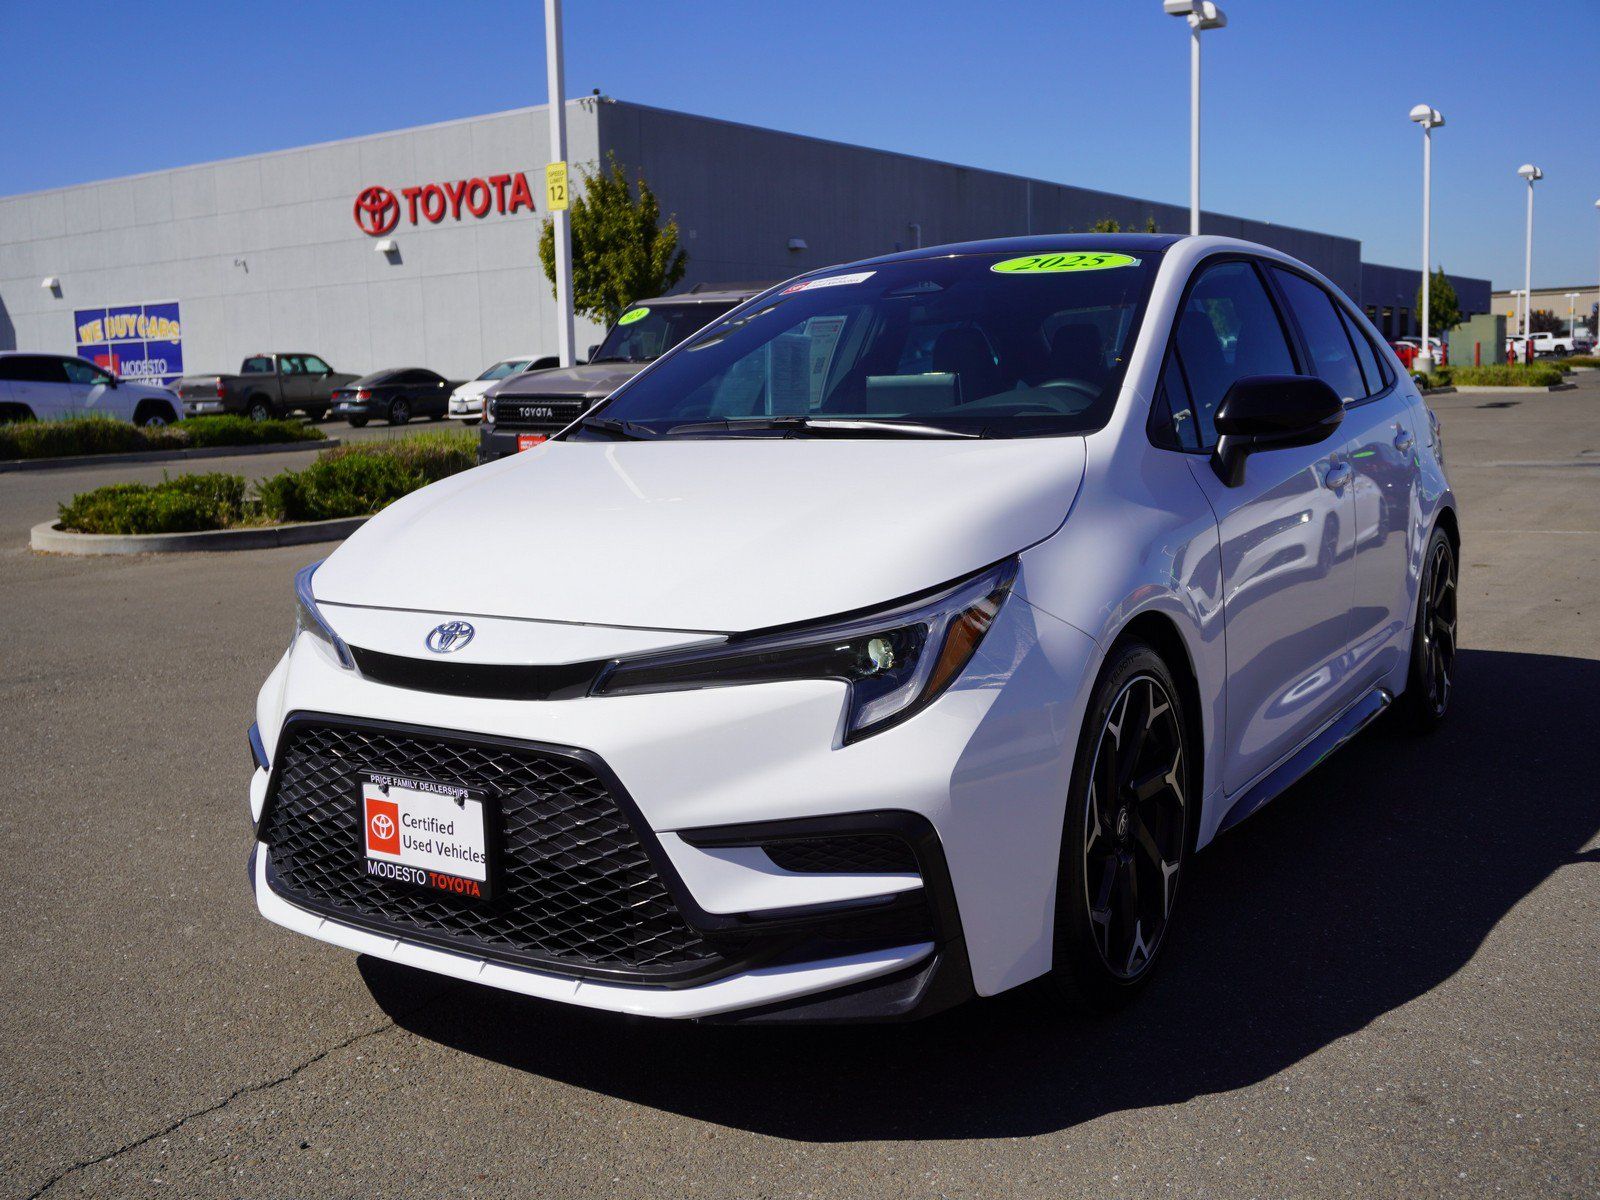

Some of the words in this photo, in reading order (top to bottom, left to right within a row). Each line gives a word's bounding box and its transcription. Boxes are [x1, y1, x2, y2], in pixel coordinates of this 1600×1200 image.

[401, 172, 535, 225] TOYOTA
[549, 185, 564, 201] 12
[1013, 255, 1113, 270] 2025
[79, 319, 103, 345] WE
[104, 314, 137, 339] BUY
[137, 314, 180, 345] CARS
[121, 358, 167, 376] MODESTO
[519, 407, 553, 417] TOYOTA
[370, 774, 392, 786] PRICE
[393, 778, 418, 789] FAMILY
[419, 782, 469, 798] DEALERSHIPS
[402, 812, 455, 836] Certified
[403, 834, 432, 854] Used
[435, 841, 487, 864] Vehicles
[367, 860, 427, 885] MODESTO
[429, 872, 481, 897] TOYOTA
